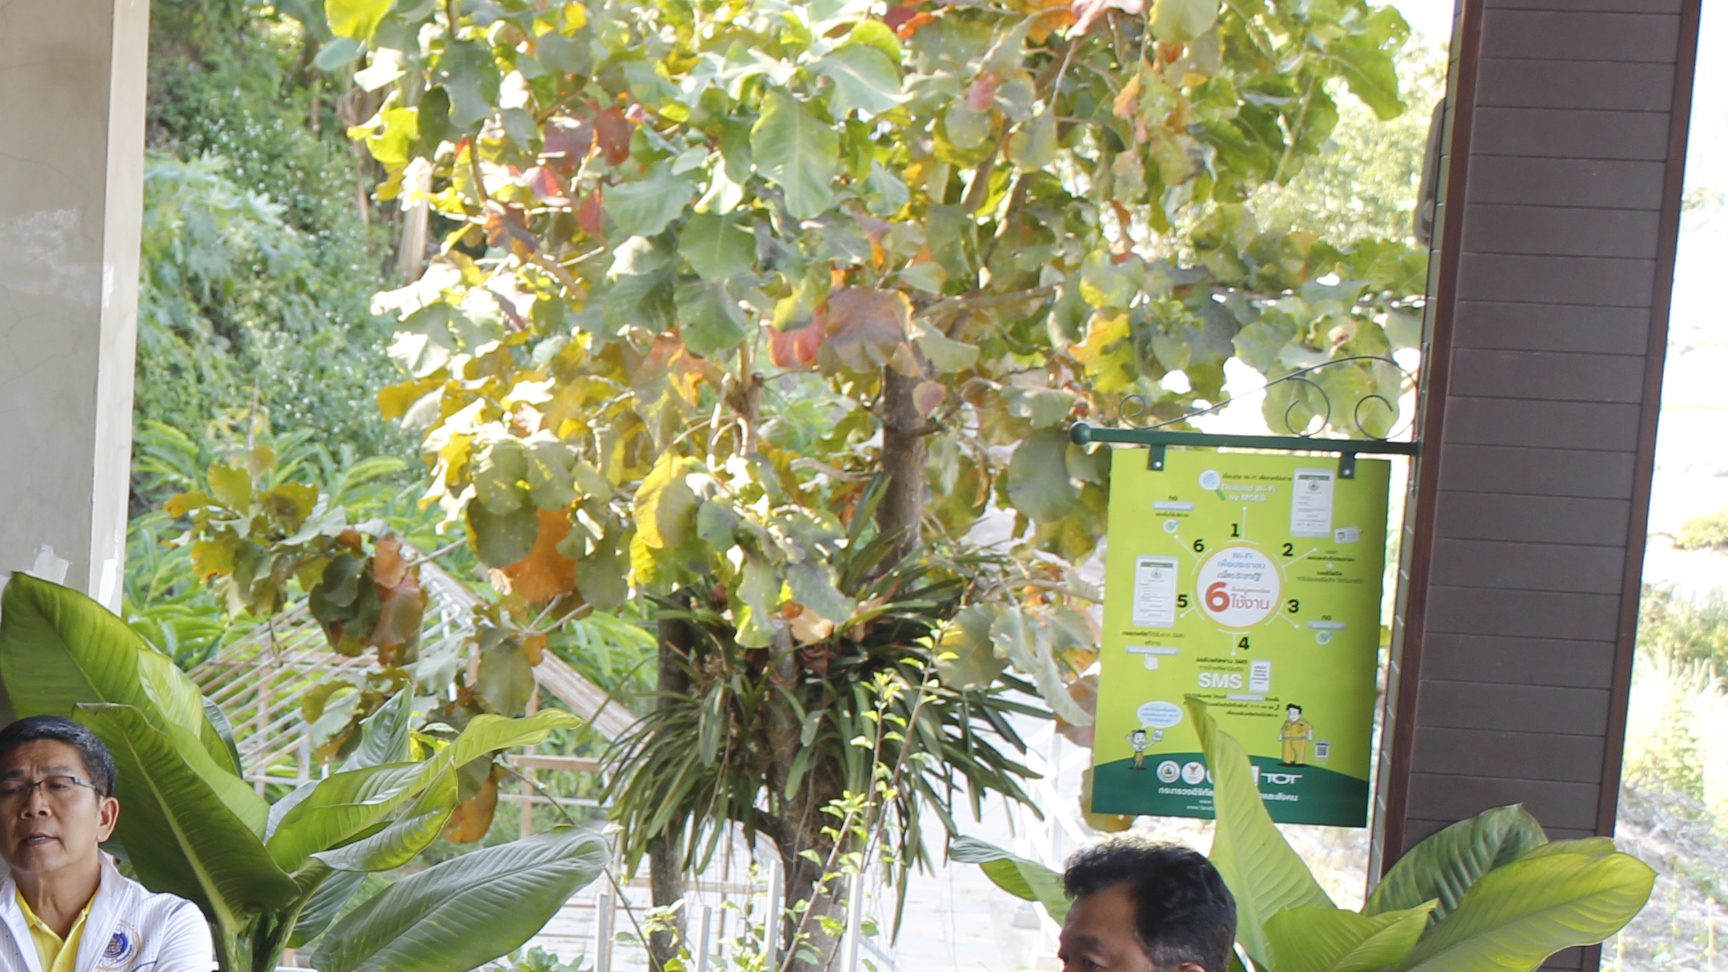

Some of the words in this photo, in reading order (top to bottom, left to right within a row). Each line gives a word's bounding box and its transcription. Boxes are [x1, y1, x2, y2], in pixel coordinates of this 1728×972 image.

[1231, 523, 1240, 537] 1
[1193, 539, 1204, 552] 6
[1282, 543, 1293, 556] 2
[1177, 594, 1188, 607] 5
[1205, 581, 1230, 612] 6
[1287, 599, 1299, 613] 3
[1238, 636, 1249, 650] 4
[1198, 672, 1243, 690] SMS
[1260, 773, 1303, 784] TOT
